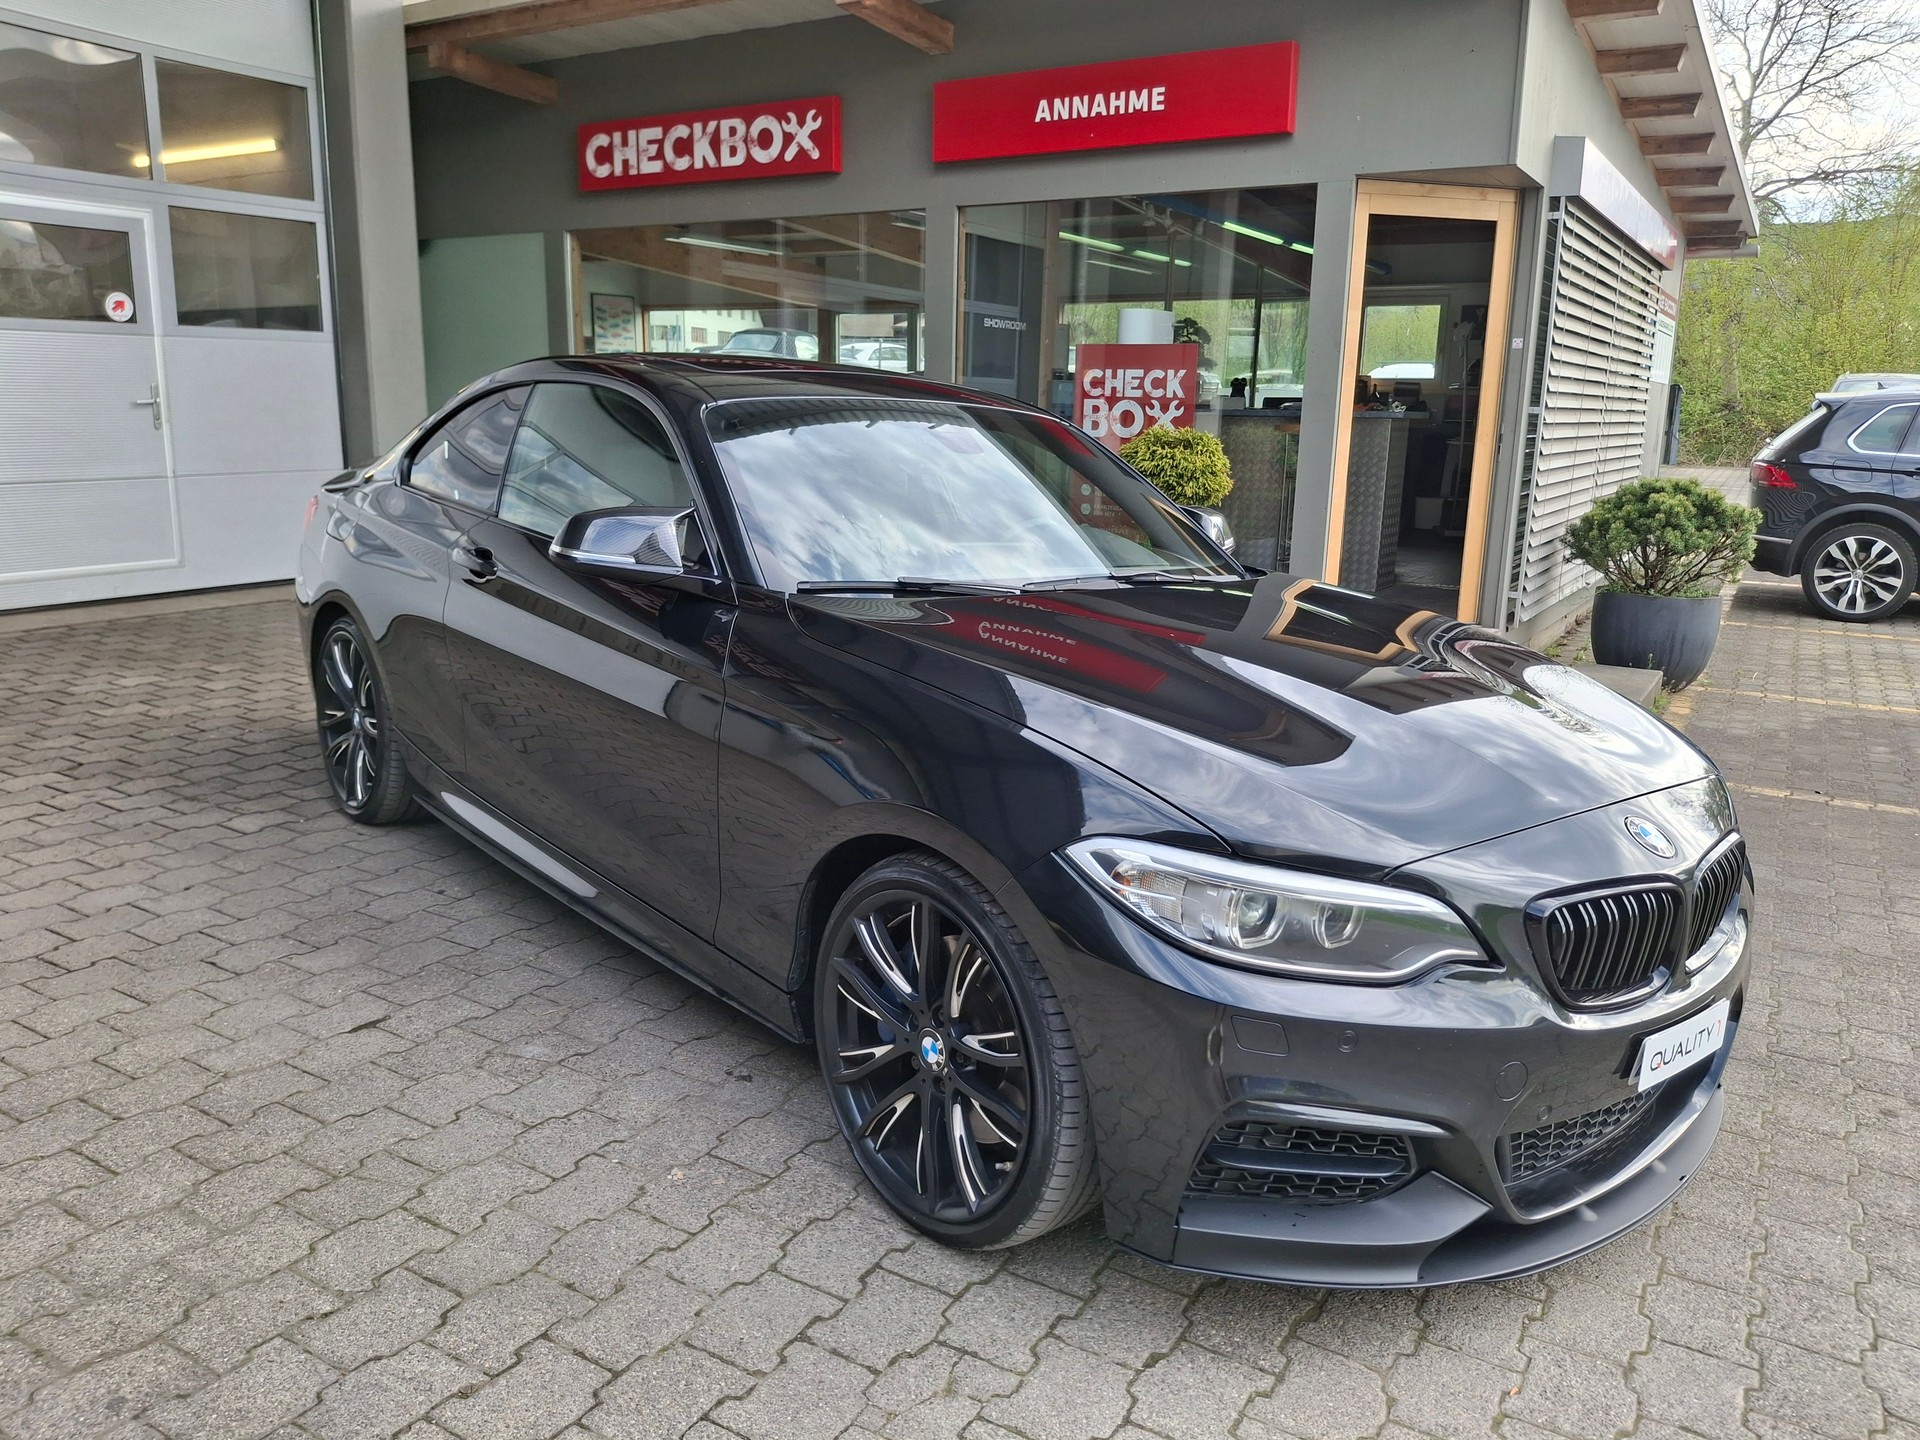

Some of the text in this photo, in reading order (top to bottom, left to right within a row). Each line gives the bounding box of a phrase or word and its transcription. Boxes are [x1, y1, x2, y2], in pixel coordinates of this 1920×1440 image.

[1034, 86, 1167, 123] ANNAHME
[585, 108, 823, 179] CHECKBOX
[983, 317, 1027, 331] SHOWROOM
[1083, 368, 1187, 398] CHECK
[1083, 398, 1185, 438] BOX
[1649, 1019, 1722, 1072] QUALITY 1
